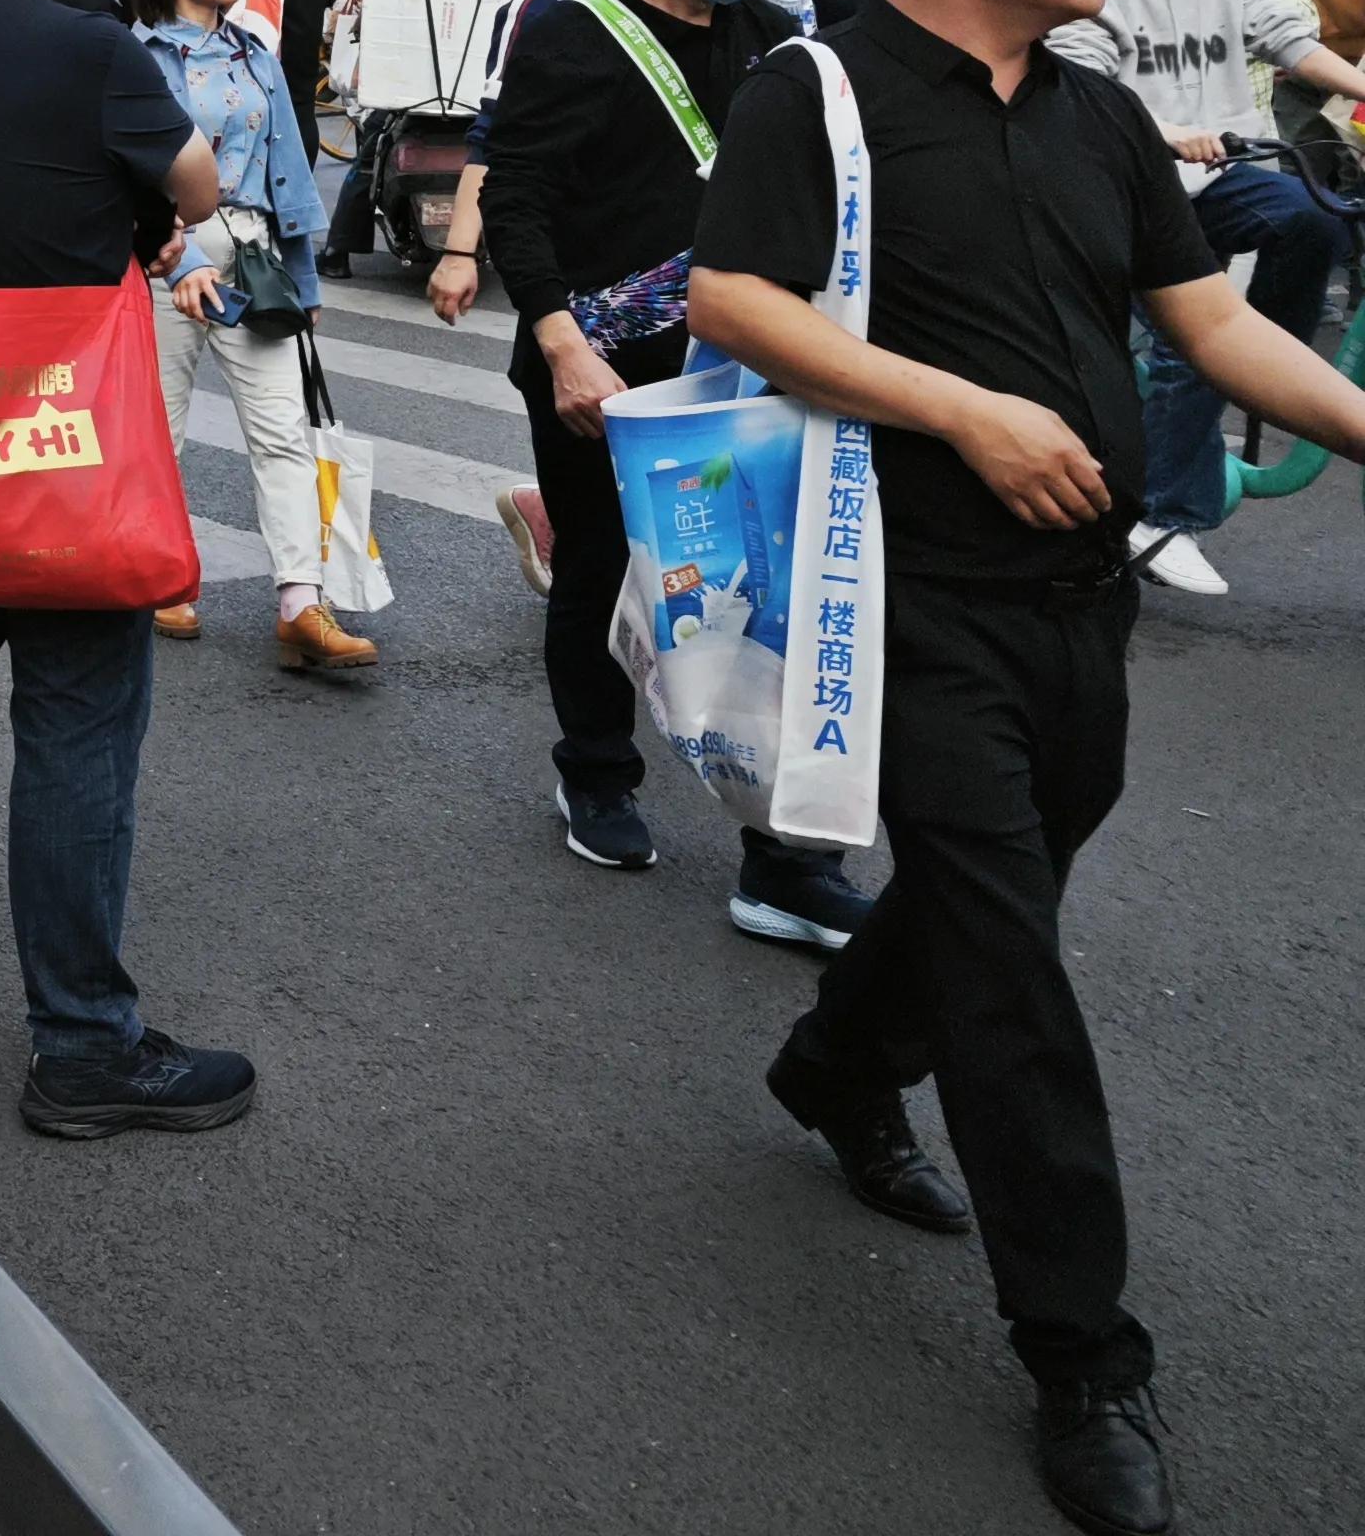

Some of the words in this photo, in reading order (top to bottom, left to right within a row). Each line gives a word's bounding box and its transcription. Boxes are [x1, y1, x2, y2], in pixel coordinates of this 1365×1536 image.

[27, 422, 81, 457] Hi
[813, 417, 869, 756] 西藏饭店一楼商场A
